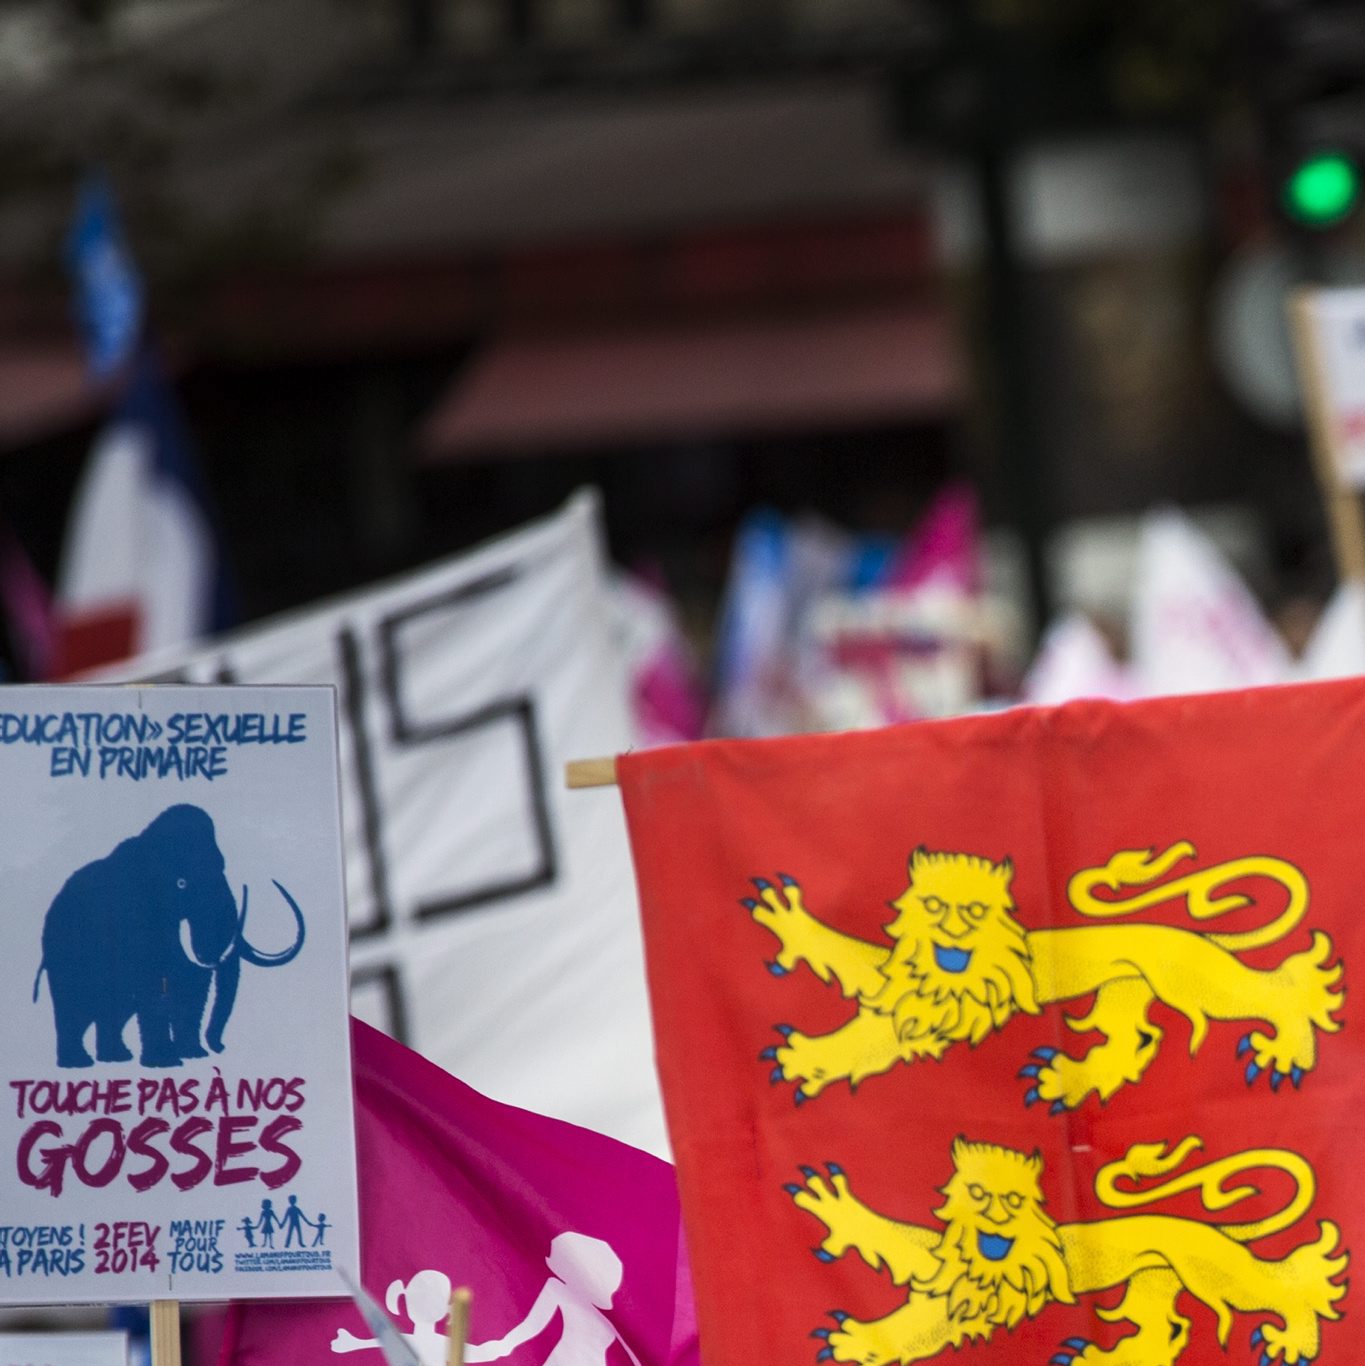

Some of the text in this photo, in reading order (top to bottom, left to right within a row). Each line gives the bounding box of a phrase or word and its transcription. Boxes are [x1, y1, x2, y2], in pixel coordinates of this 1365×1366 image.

[0, 712, 306, 746] DUCATION» SEXUELLE
[50, 746, 228, 781] EN PRIMAIRE
[10, 1066, 306, 1118] TOUCHE PAS À NOS
[16, 1114, 304, 1198] GOSSES
[0, 1226, 73, 1248] TOYENS
[169, 1220, 226, 1238] MANIF
[94, 1246, 160, 1274] 2014
[174, 1237, 222, 1255] POUR
[17, 1248, 86, 1277] PARIS
[167, 1251, 224, 1273] TOUS
